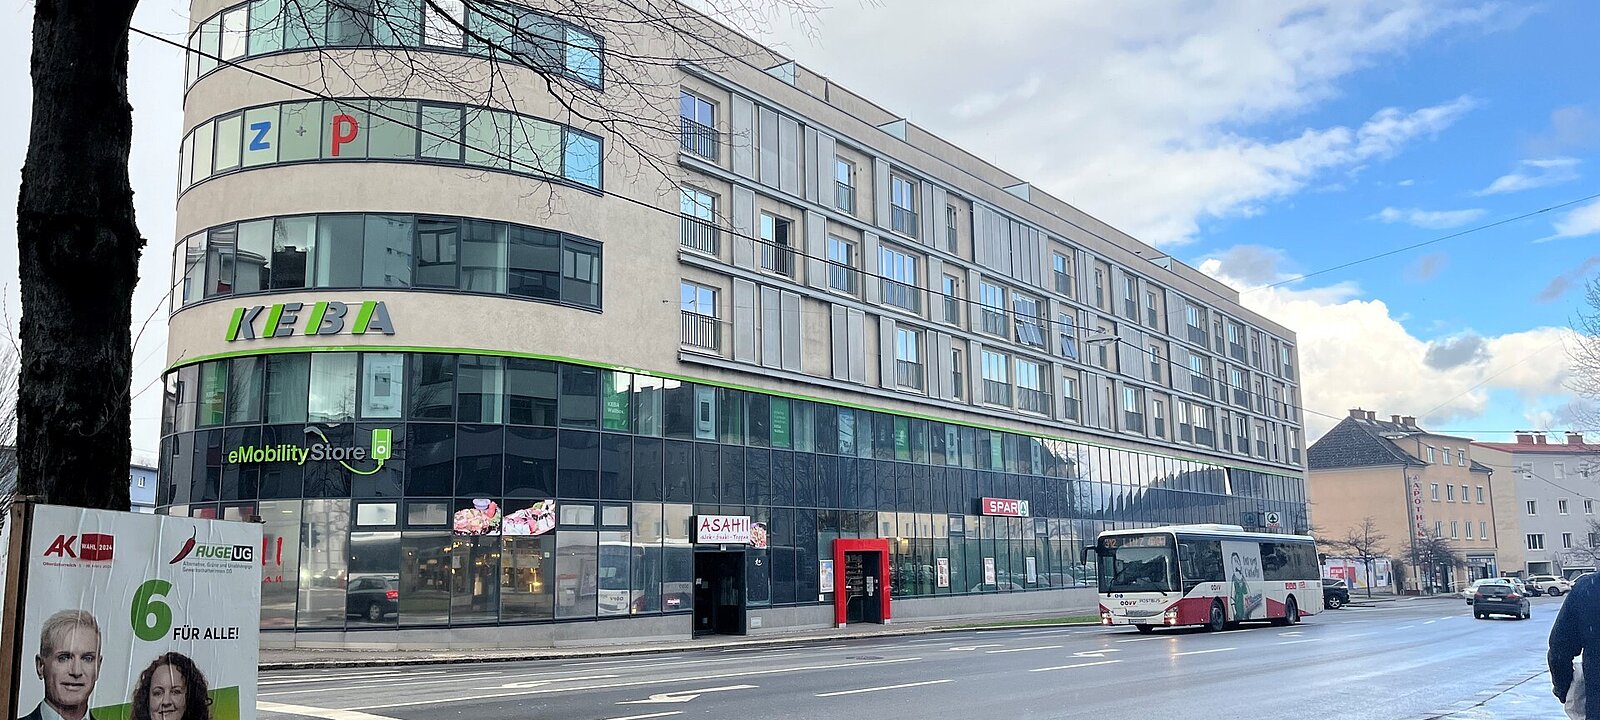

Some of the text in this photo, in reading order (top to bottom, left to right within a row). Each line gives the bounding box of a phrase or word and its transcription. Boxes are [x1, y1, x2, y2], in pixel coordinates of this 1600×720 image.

[225, 300, 396, 341] KEBA
[990, 500, 1018, 513] SPAR
[43, 534, 78, 558] AK
[82, 543, 97, 551] WAHL
[129, 578, 173, 642] 6
[173, 624, 239, 640] FÜR ALLE!
